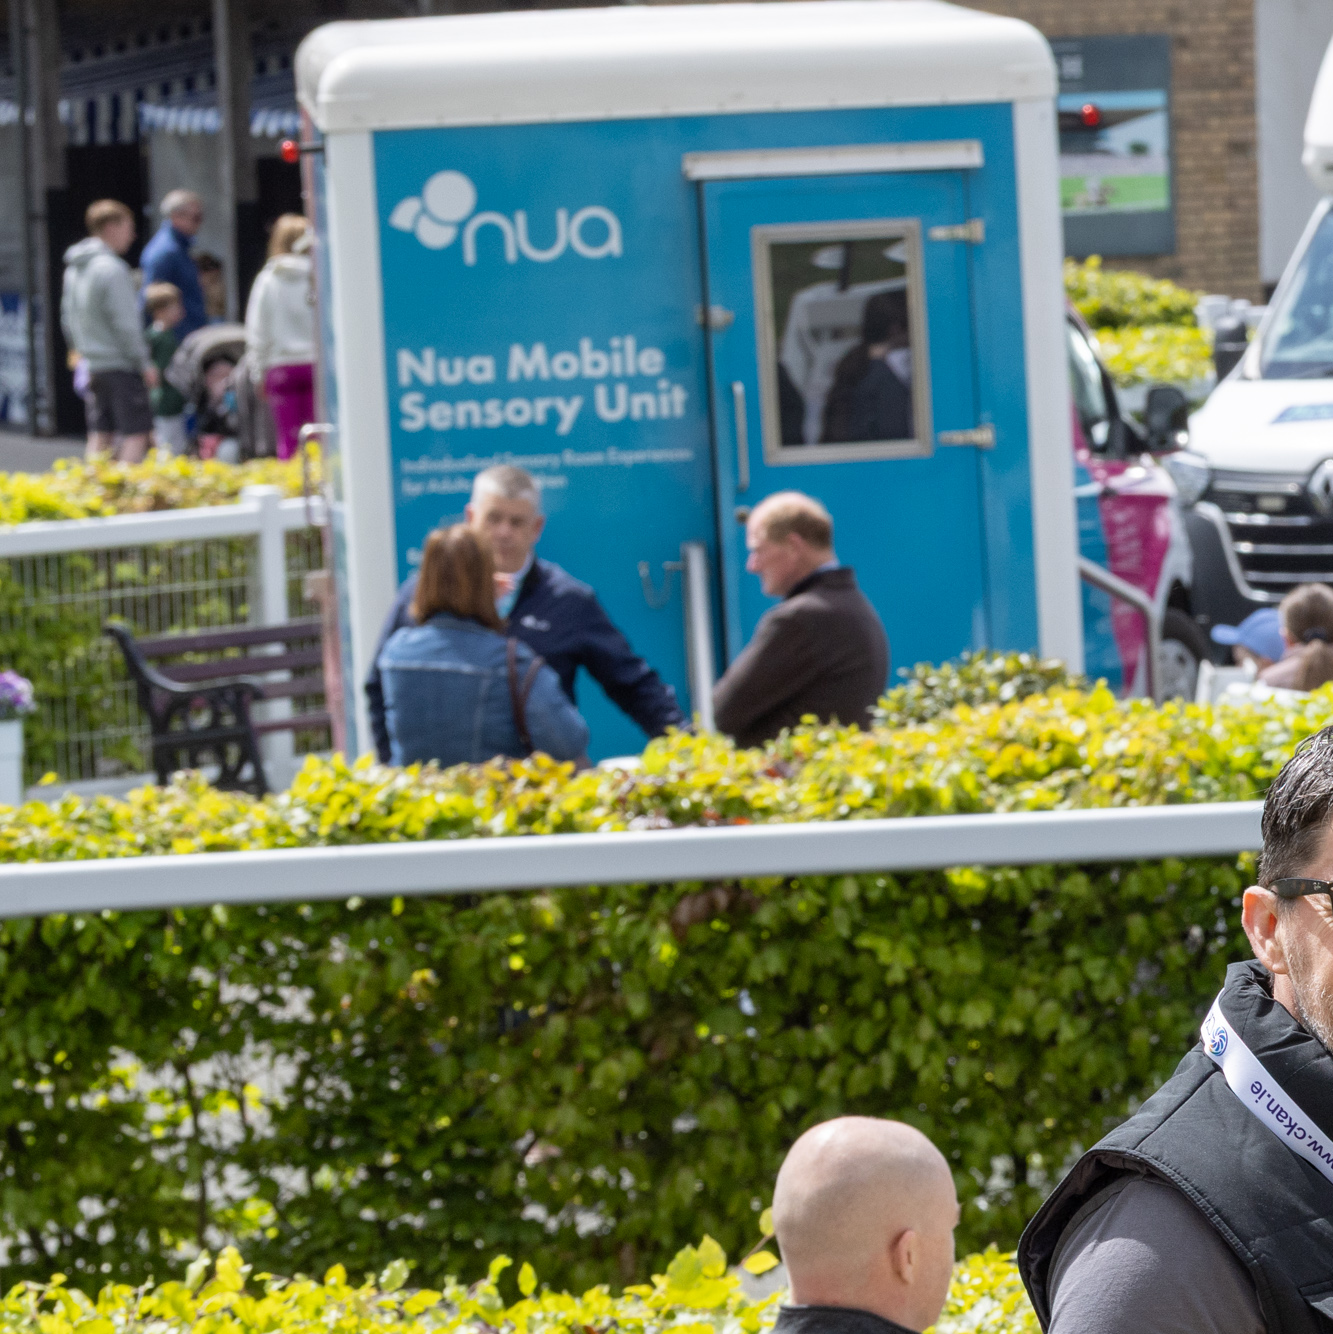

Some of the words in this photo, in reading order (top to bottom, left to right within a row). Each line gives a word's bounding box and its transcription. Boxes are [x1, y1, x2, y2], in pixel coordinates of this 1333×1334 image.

[462, 206, 623, 267] nua
[397, 347, 496, 387] Nua
[507, 336, 666, 381] Mobile
[400, 391, 584, 436] Sensory
[594, 379, 687, 422] Unit
